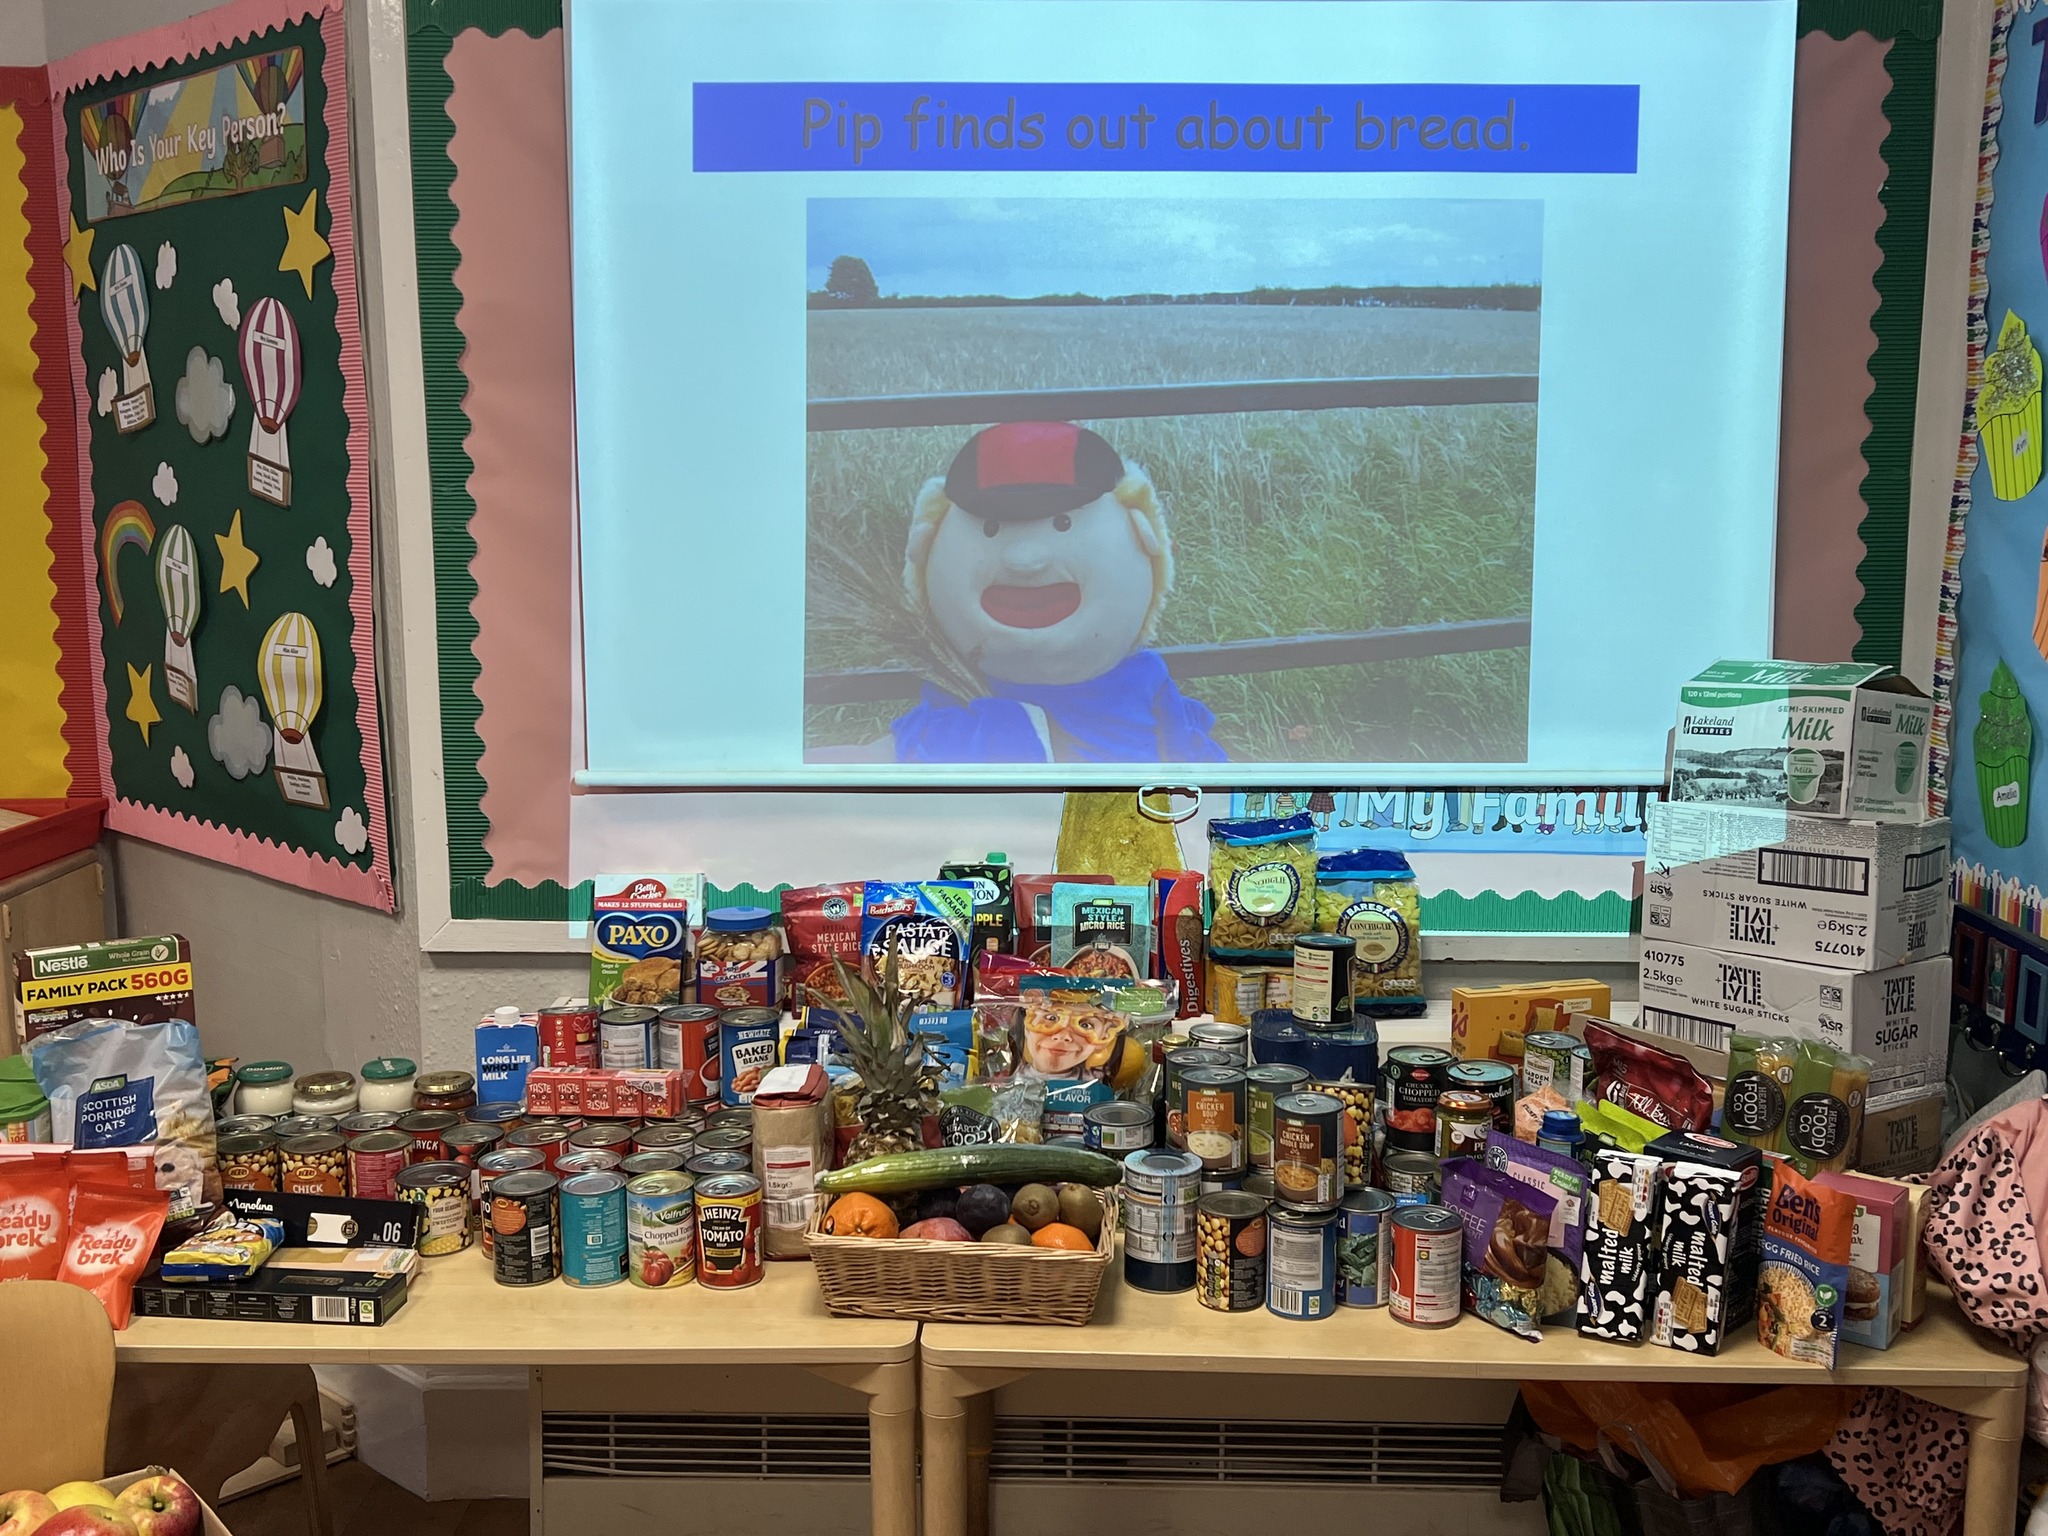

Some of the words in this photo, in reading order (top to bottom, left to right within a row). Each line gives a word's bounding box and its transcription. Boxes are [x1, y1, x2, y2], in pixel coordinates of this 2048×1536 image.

[802, 98, 882, 165] Pip
[903, 96, 1045, 151] finds
[1067, 104, 1155, 150] out
[1175, 100, 1332, 150] about
[1356, 99, 1528, 151] bread.
[96, 143, 126, 175] Who
[130, 139, 144, 167] Is
[149, 133, 181, 162] Your
[187, 124, 216, 159] Key
[222, 102, 287, 149] Person?
[1742, 669, 1812, 685] Milk
[1717, 692, 1742, 700] portions
[1778, 705, 1844, 714] SEMI-SKIMMED
[1692, 716, 1735, 727] Lakeland
[1896, 713, 1925, 736] Milk
[1693, 727, 1731, 735] DAIRIES
[1782, 717, 1834, 742] Milk
[1794, 766, 1813, 774] Milk
[1996, 787, 2018, 801] Amelia
[1357, 787, 1445, 842] My
[1472, 787, 1648, 829] Famil
[634, 883, 657, 893] Betty
[1650, 884, 1671, 894] ASR
[1702, 889, 1736, 901] STICKS
[953, 893, 968, 910] LESS
[1739, 894, 1771, 904] SUGAR
[1775, 899, 1807, 910] WHITE
[938, 889, 971, 925] PACKAGING
[1082, 907, 1124, 915] MEXICAN
[1346, 903, 1390, 917] BARESA
[1730, 904, 1772, 925] LYLE
[886, 922, 933, 937] PASTA
[1080, 921, 1104, 932] MICRO
[1106, 921, 1125, 930] RICE
[1350, 922, 1393, 930] CONCHIGLIE
[607, 925, 669, 947] PAXO
[817, 931, 857, 943] MEXICAN
[1729, 924, 1776, 945] TATE
[842, 942, 862, 951] RICE
[1815, 940, 1866, 957] 410775
[108, 951, 131, 960] Whole
[131, 949, 150, 958] Grain
[1644, 950, 1685, 967] 410775
[715, 972, 750, 983] CRACKERS
[1179, 939, 1199, 1012] Digestives
[1718, 963, 1761, 988] TATE
[27, 983, 84, 1001] FAMILY
[88, 978, 128, 997] PACK
[131, 969, 188, 990] 560G
[1884, 975, 1915, 997] TATE
[1722, 982, 1762, 1006] LYLE
[1691, 997, 1721, 1009] WHITE
[1723, 1003, 1754, 1016] SUGAR
[1757, 1010, 1790, 1023] STICKS
[1885, 994, 1914, 1016] LYLE
[1820, 1020, 1843, 1031] ASR
[1886, 1017, 1909, 1028] WHITE
[1876, 1024, 1918, 1046] SUGAR
[735, 1044, 773, 1059] BAKED
[1883, 1042, 1908, 1053] STICKS
[481, 1055, 510, 1065] LONG
[511, 1055, 531, 1064] LIFE
[742, 1054, 769, 1065] BEANS
[482, 1063, 518, 1073] WHOLE
[1525, 1069, 1549, 1082] GARDEN
[482, 1071, 508, 1081] MILK
[1527, 1076, 1542, 1086] PEAS
[94, 1080, 119, 1091] ASDA
[529, 1083, 552, 1094] TASTE
[557, 1083, 581, 1094] TASTE
[1399, 1086, 1440, 1097] CHOPPED
[82, 1094, 137, 1112] SCOTTISH
[1053, 1094, 1091, 1104] FLAVOR
[1196, 1102, 1224, 1111] CHICKEN
[1744, 1083, 1758, 1124] FOOD
[1758, 1086, 1767, 1121] HEARTY
[81, 1105, 136, 1124] PORRIDGE
[95, 1119, 126, 1133] OATS
[1812, 1105, 1828, 1148] FOOD
[1827, 1110, 1837, 1145] HEARTY
[1888, 1115, 1917, 1137] TATE
[1282, 1130, 1310, 1143] CHICKEN
[1280, 1138, 1297, 1149] NOODLE
[1299, 1141, 1314, 1151] SOUP
[1890, 1134, 1918, 1155] LYLE
[293, 1184, 323, 1193] CHICK
[228, 1198, 273, 1212] Napolina
[1707, 1199, 1716, 1218] Tower
[1776, 1183, 1821, 1225] Ben's
[704, 1207, 739, 1221] HEINZ
[1443, 1200, 1487, 1233] TOFFEE
[1709, 1218, 1719, 1235] Gate
[1773, 1207, 1818, 1242] Original
[383, 1222, 401, 1243] 06
[644, 1228, 678, 1241] Chopped
[702, 1228, 744, 1242] TOMATO
[1767, 1225, 1793, 1240] FLAVOUR
[77, 1234, 138, 1252] Ready
[1662, 1233, 1673, 1252] Udderly
[77, 1250, 123, 1267] brek
[1598, 1228, 1619, 1285] malted
[1618, 1247, 1633, 1274] milk
[1672, 1240, 1686, 1267] milk
[1686, 1231, 1708, 1287] malted
[1760, 1240, 1778, 1254] EGG
[1780, 1249, 1803, 1266] FRIED
[1804, 1259, 1820, 1276] RICE
[1631, 1262, 1642, 1281] Udderly
[1589, 1297, 1597, 1318] Tower
[1819, 1315, 1827, 1327] 2
